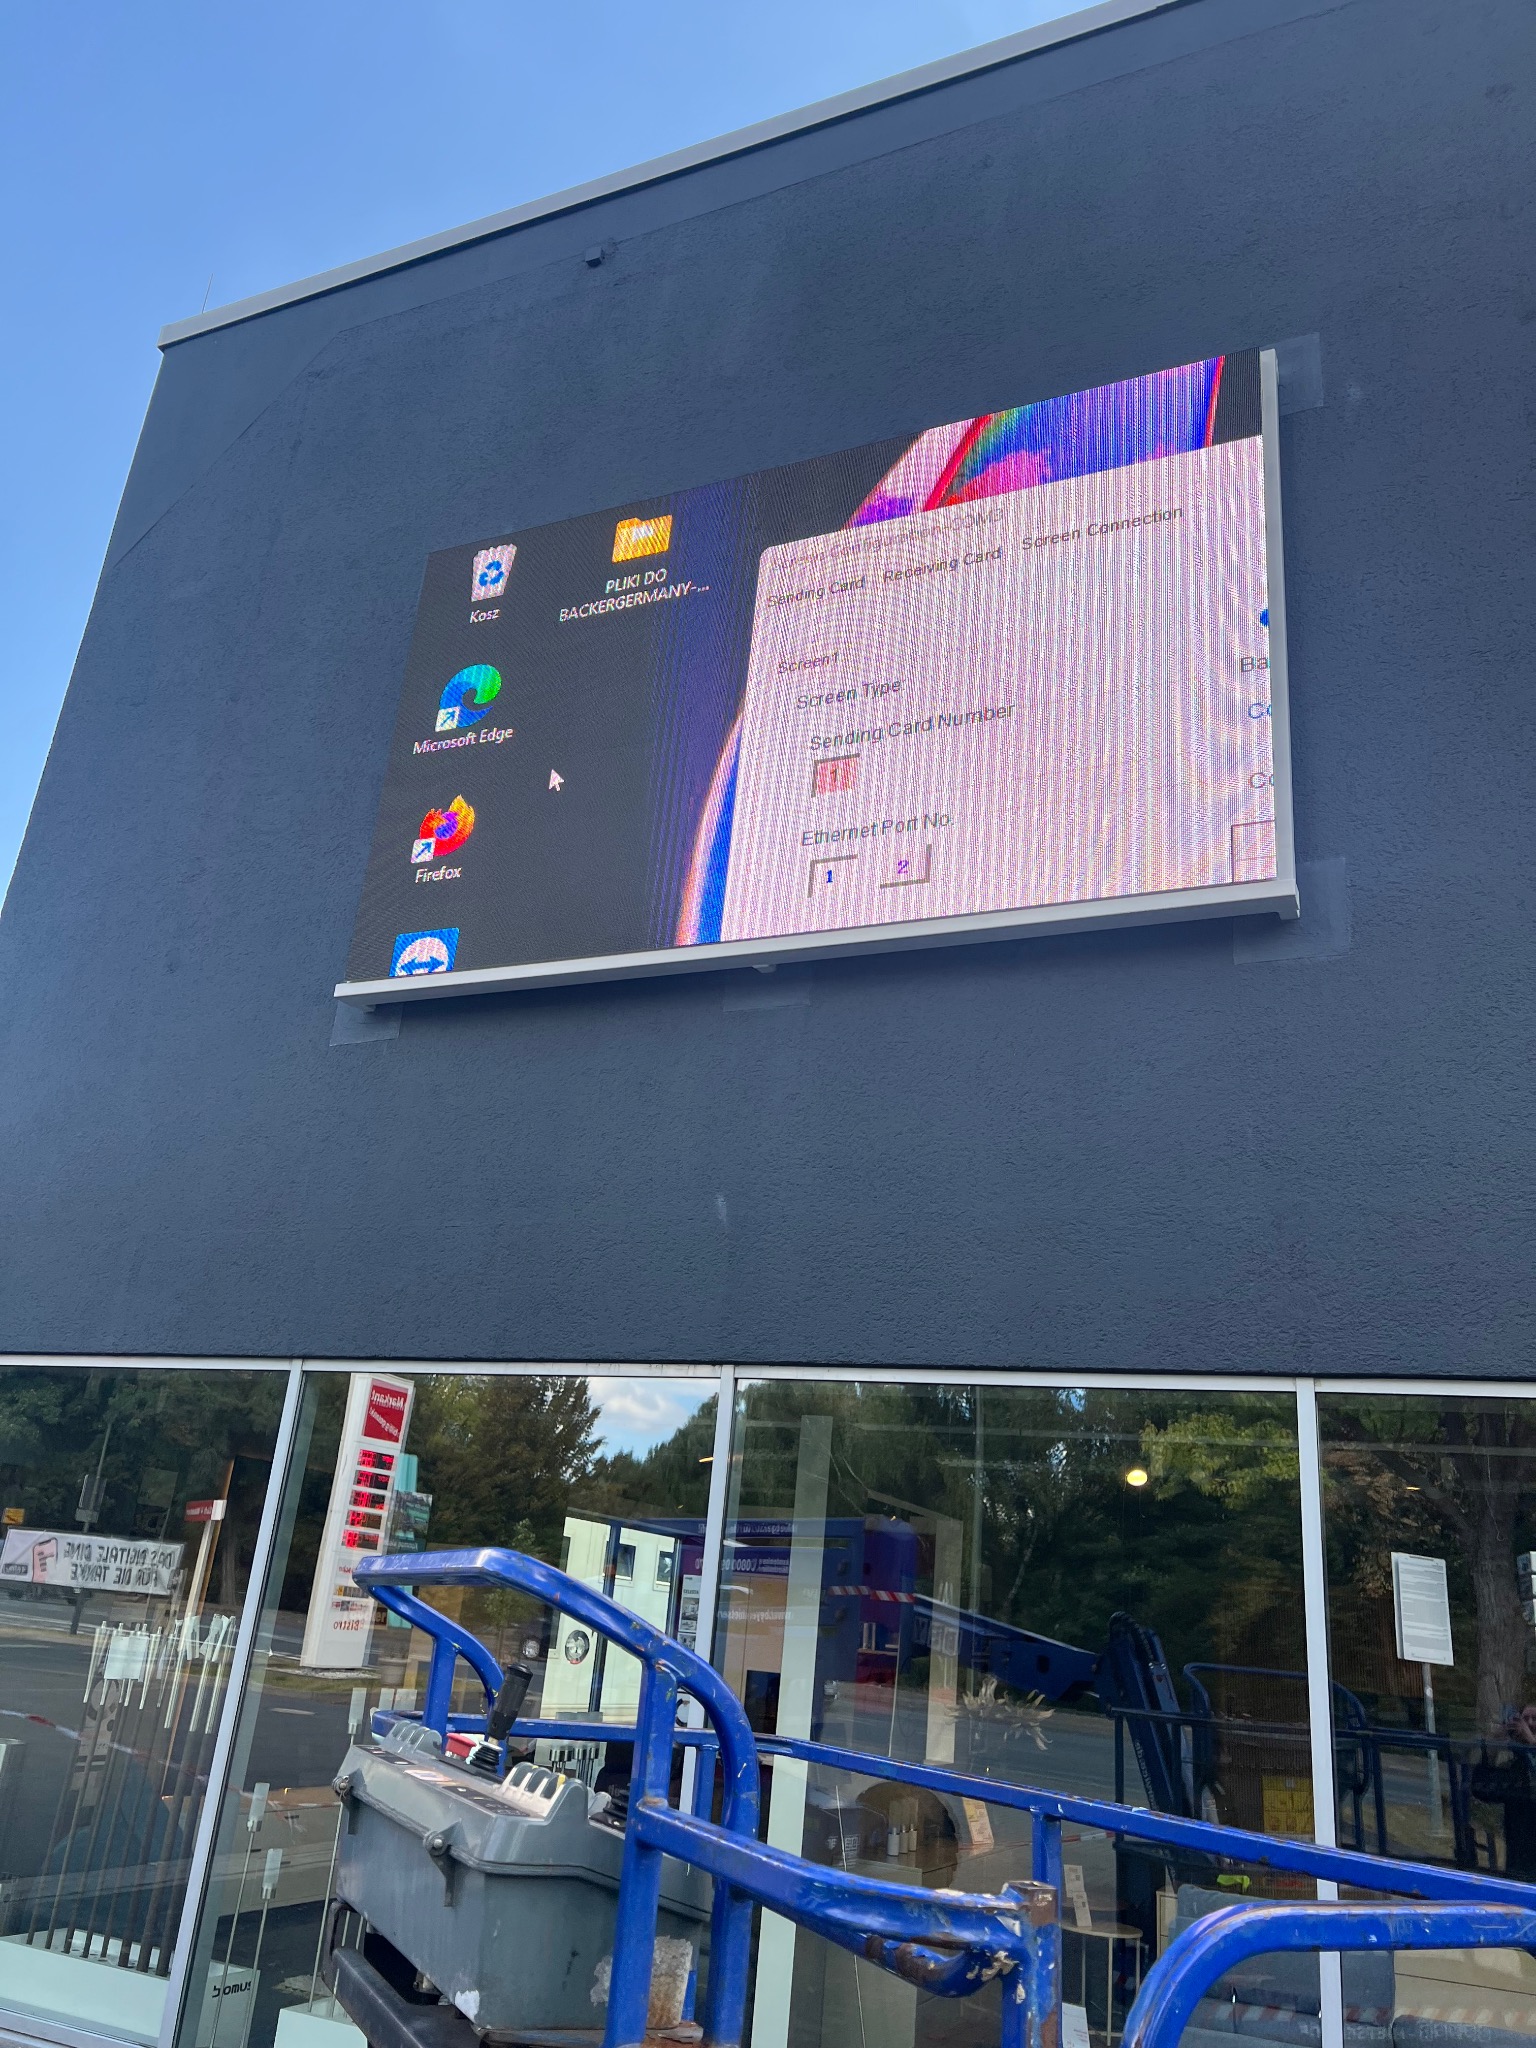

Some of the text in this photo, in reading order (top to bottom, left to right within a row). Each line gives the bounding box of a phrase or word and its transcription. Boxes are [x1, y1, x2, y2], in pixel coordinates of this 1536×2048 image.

[1022, 506, 1184, 551] Screen Connection
[883, 546, 1003, 584] Receiving Card
[605, 567, 669, 595] PLIKI DO
[766, 575, 867, 611] Sending Card
[469, 607, 500, 624] Kosz
[796, 686, 858, 711] Screen
[412, 725, 514, 756] Microsoft Edge
[810, 703, 1016, 752] Sending Card Number
[830, 767, 840, 784] 1
[801, 823, 877, 847] Ethernet
[881, 817, 918, 836] Port
[414, 865, 463, 884] Firefox
[825, 858, 910, 884] 1 2
